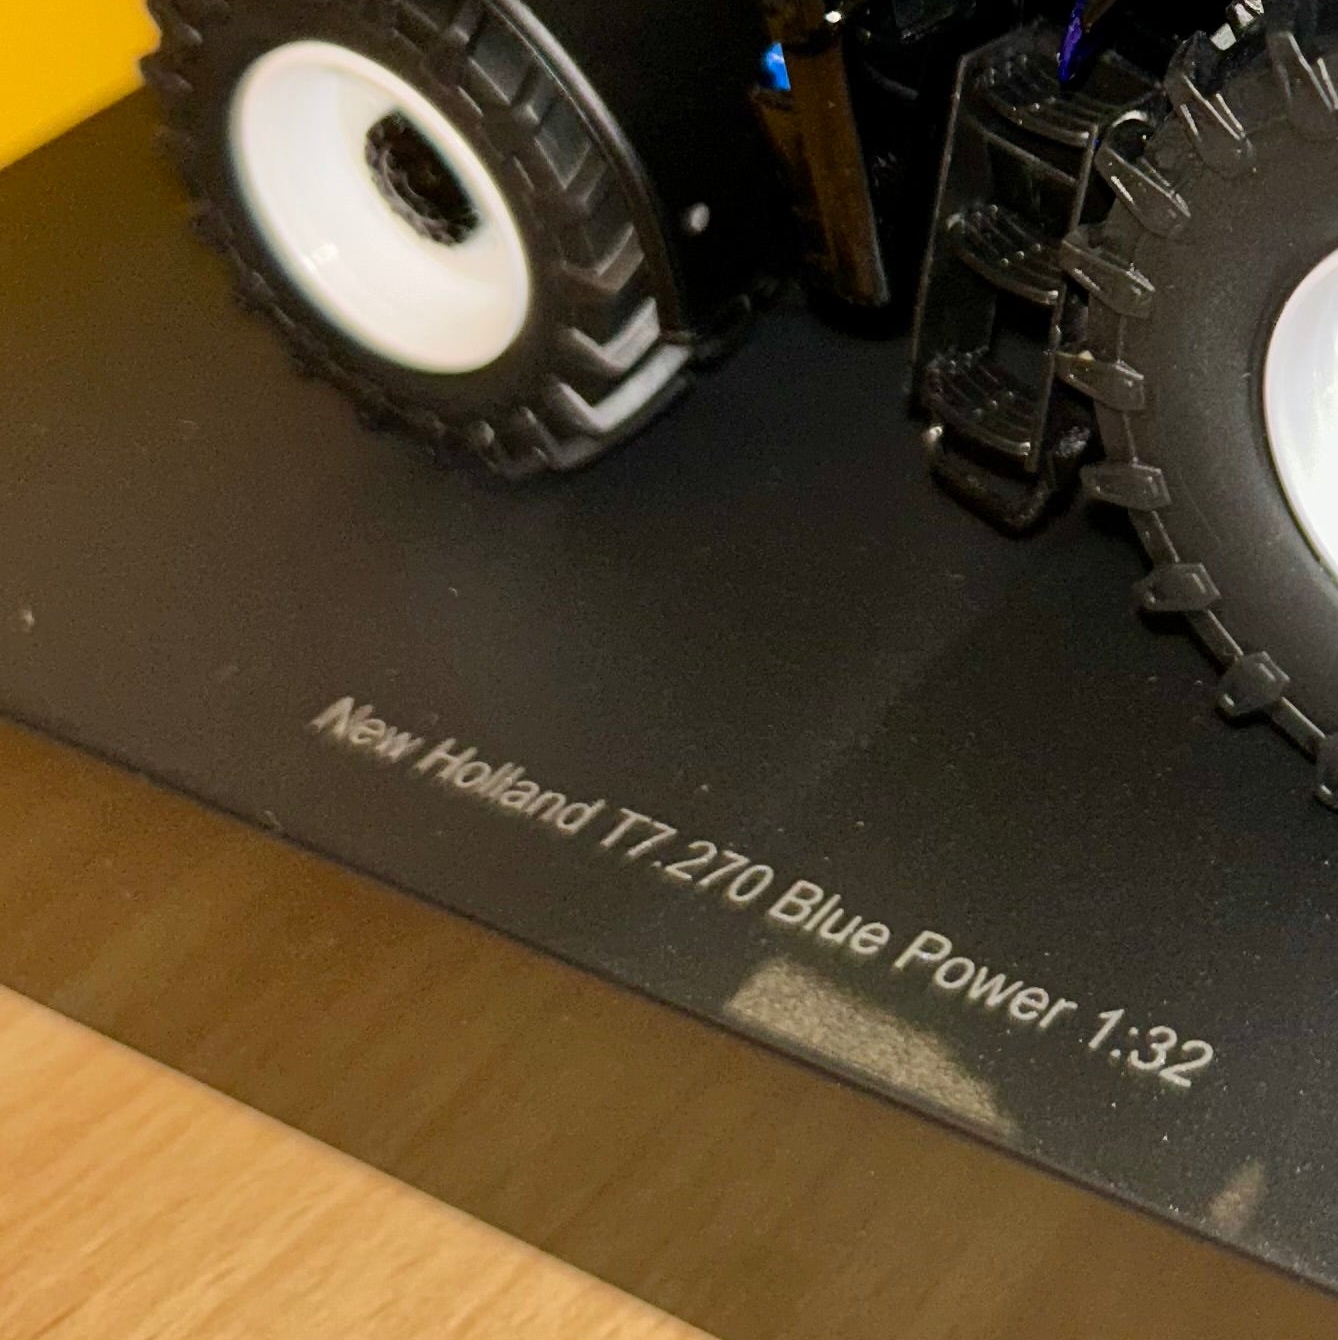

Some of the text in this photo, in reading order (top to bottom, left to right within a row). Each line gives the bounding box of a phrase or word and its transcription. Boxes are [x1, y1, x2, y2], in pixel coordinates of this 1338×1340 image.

[310, 695, 1214, 1089] New Holland T7.270 Blue Power 1:32
